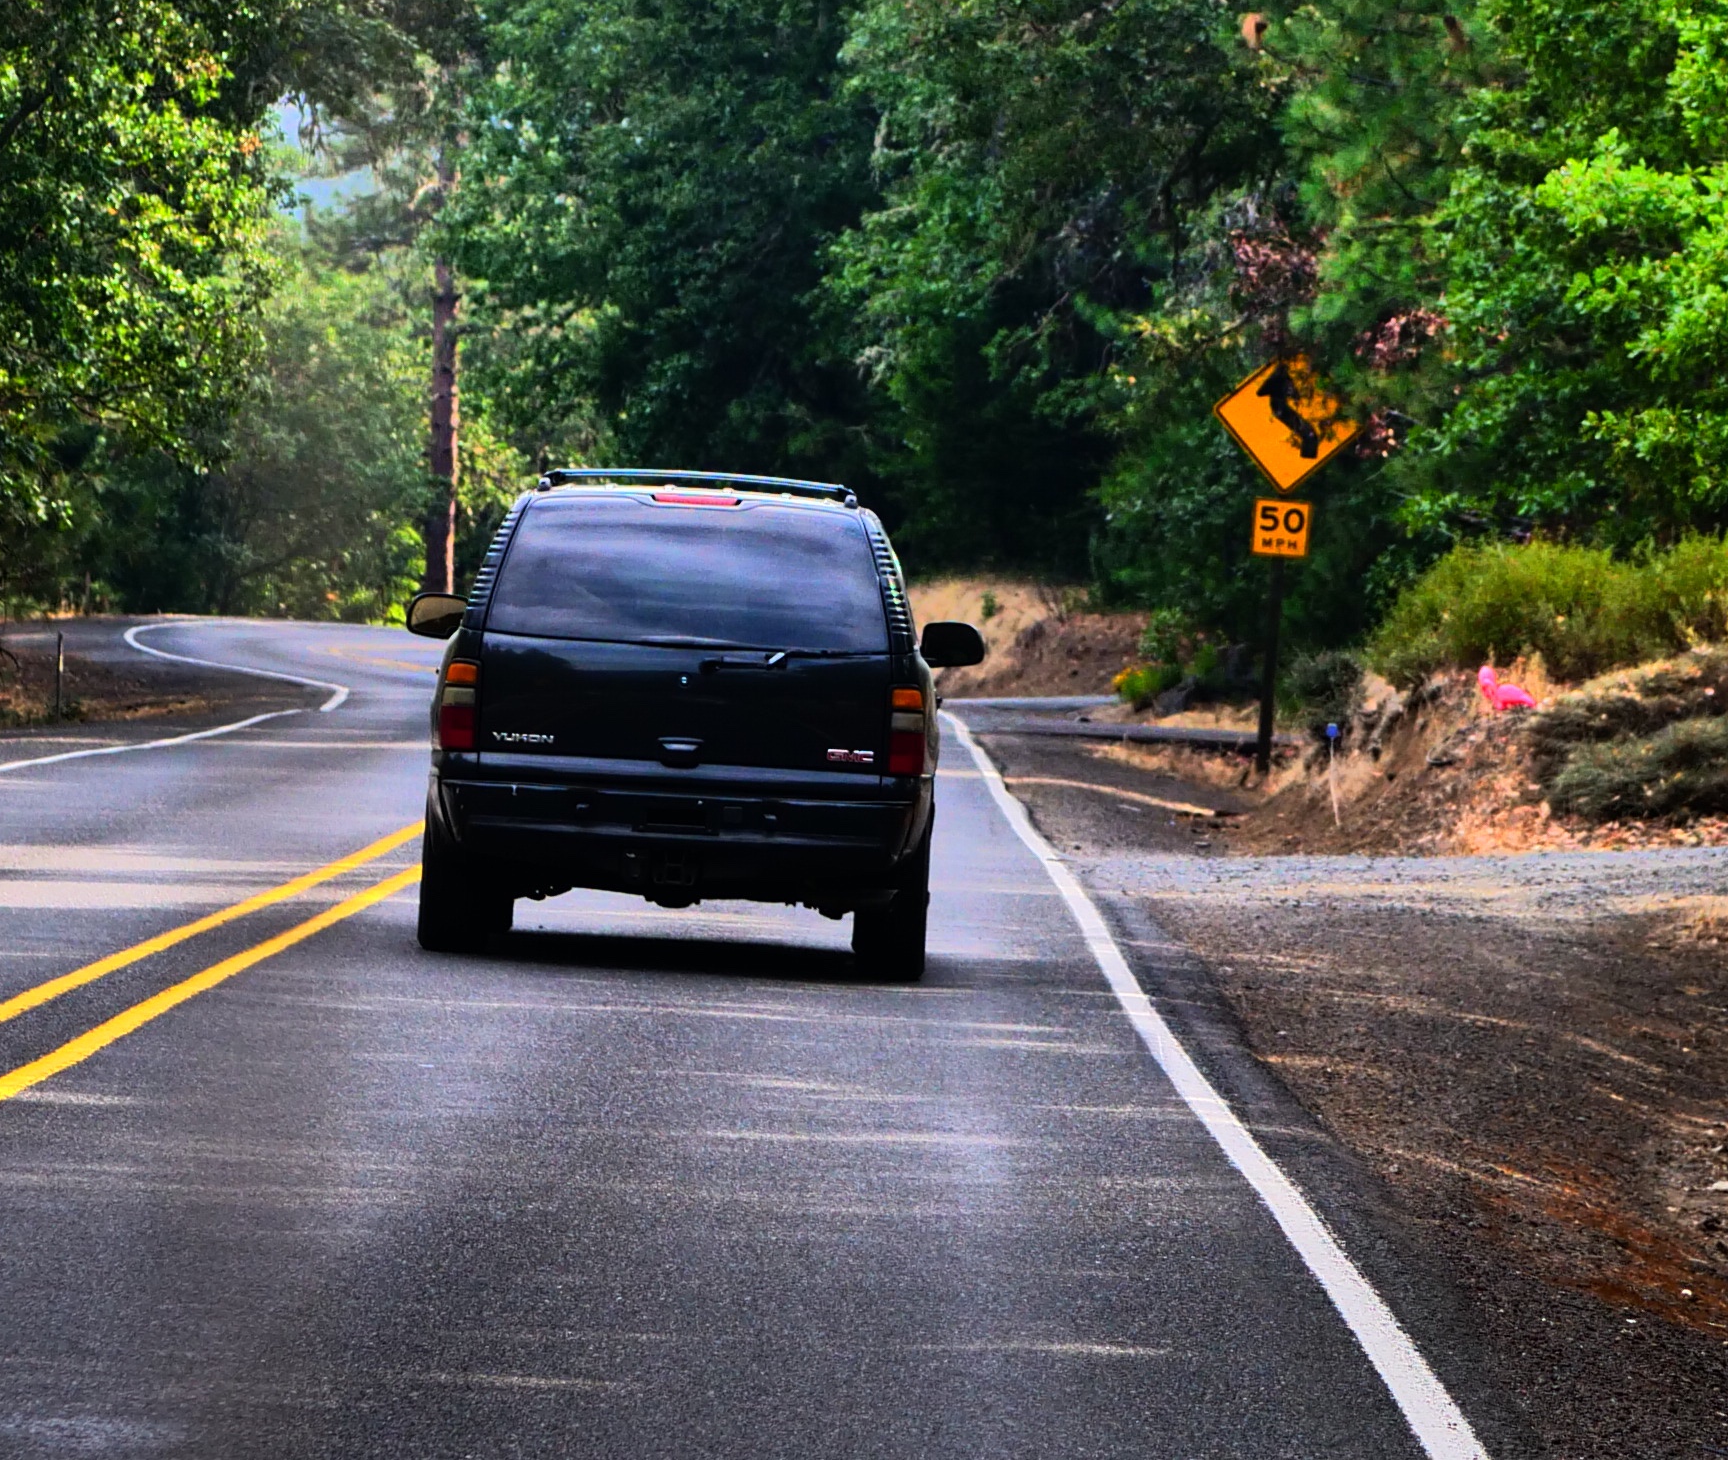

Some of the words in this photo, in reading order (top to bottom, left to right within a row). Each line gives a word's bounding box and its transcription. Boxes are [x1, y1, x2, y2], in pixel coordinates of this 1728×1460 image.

[1260, 506, 1304, 534] 50
[1262, 538, 1297, 549] MPH
[492, 731, 554, 743] YUKON
[827, 749, 874, 762] GMC
